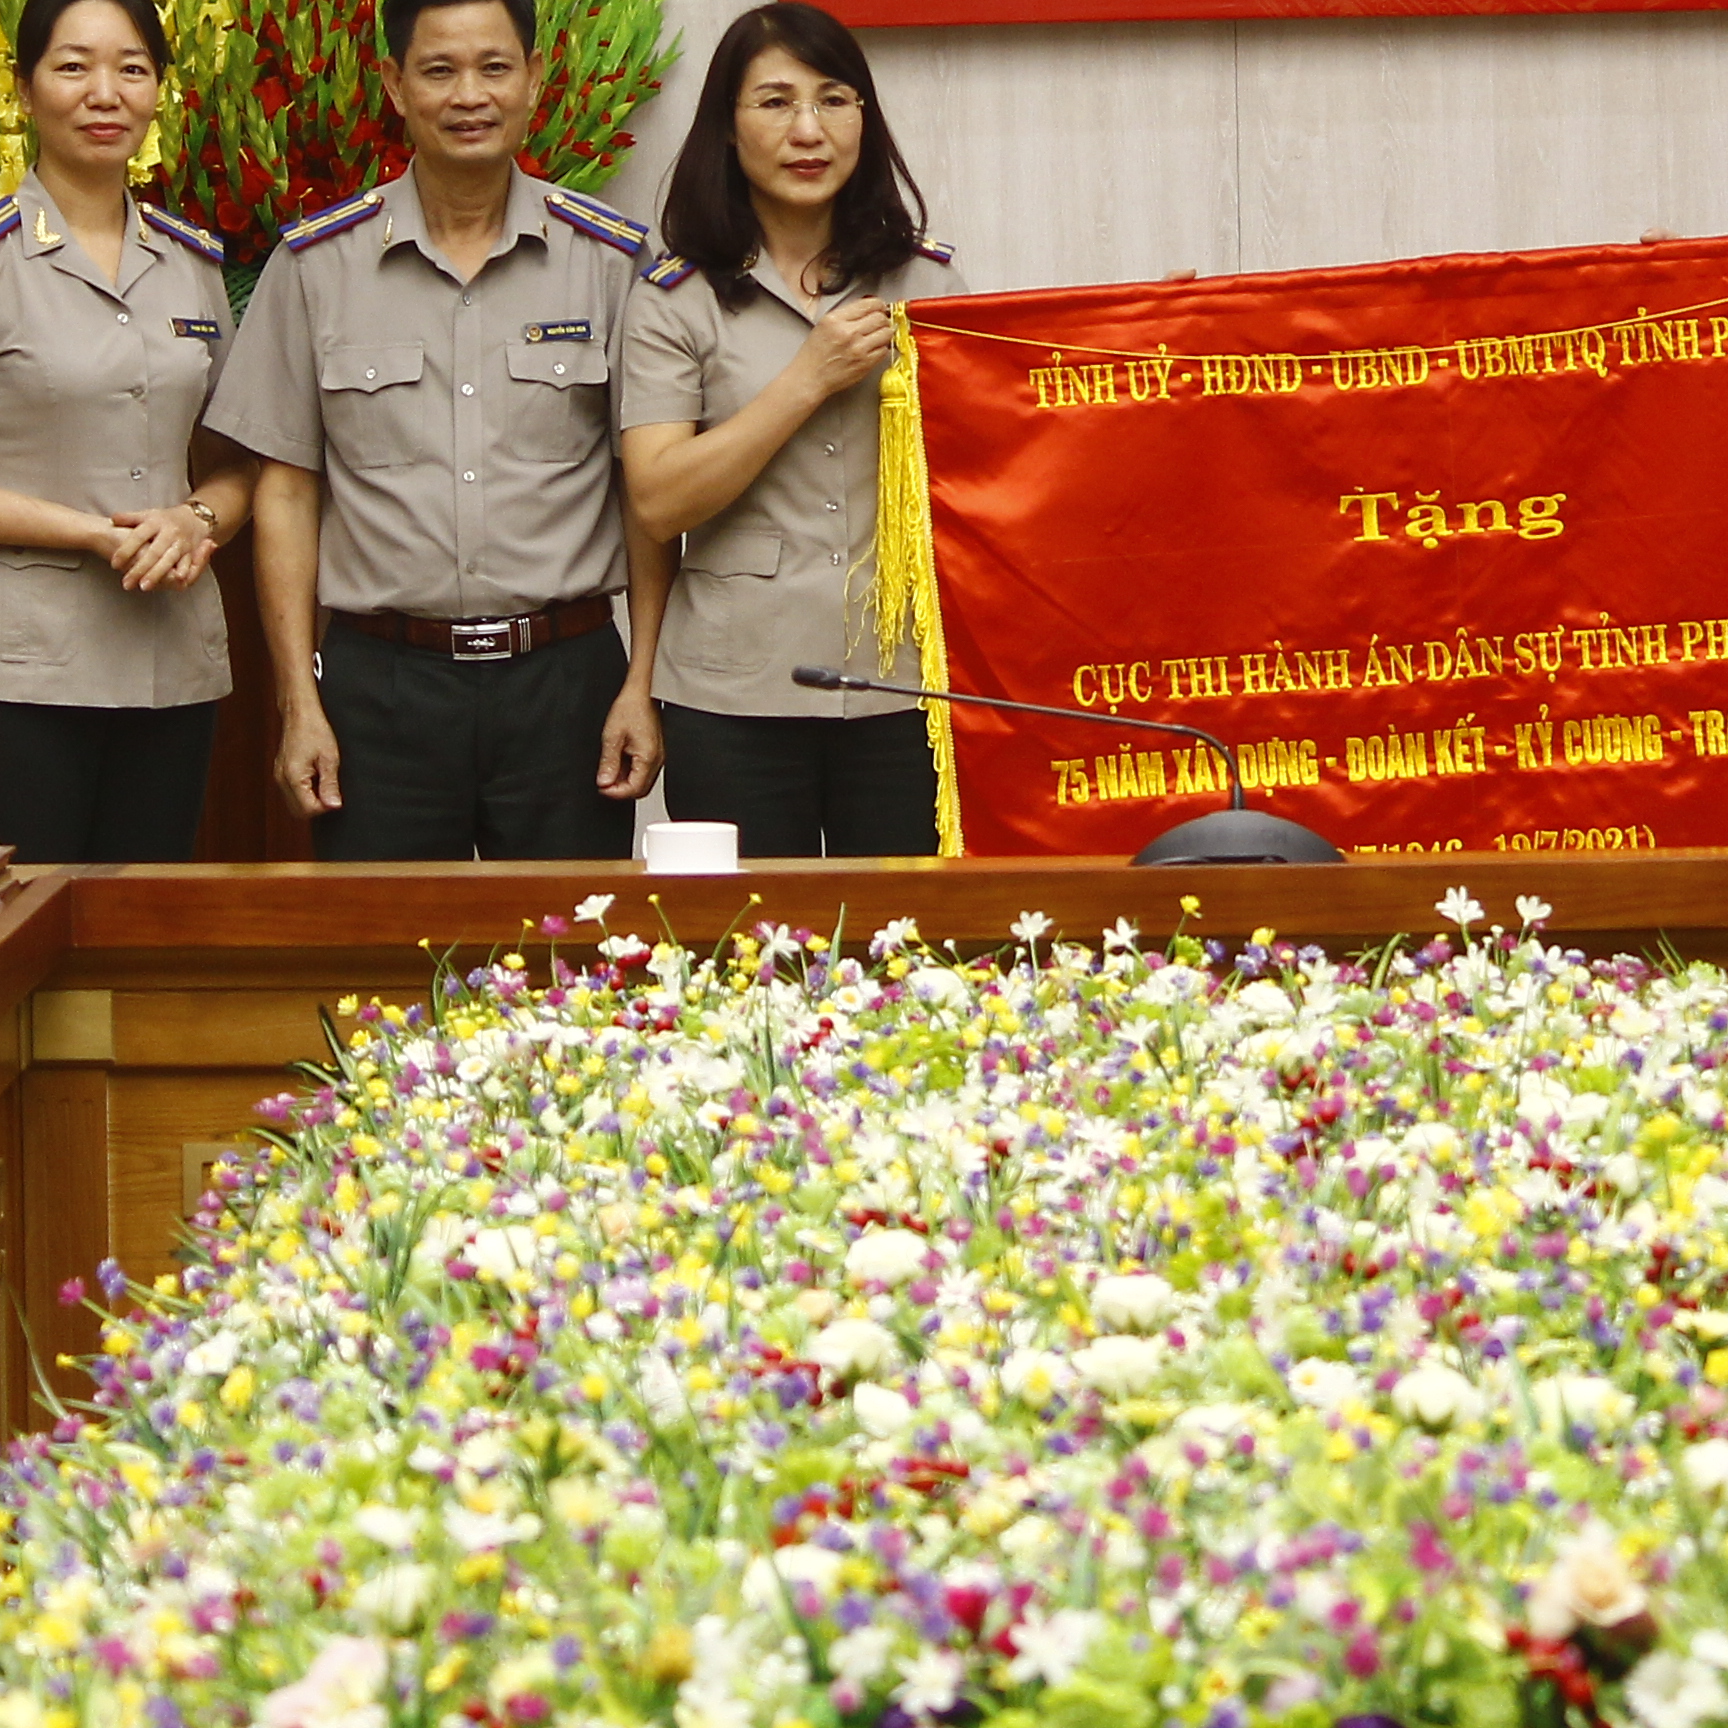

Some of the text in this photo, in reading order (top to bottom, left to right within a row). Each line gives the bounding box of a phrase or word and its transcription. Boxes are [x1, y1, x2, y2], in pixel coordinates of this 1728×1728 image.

[1029, 351, 1118, 408] TỈNH
[1124, 343, 1173, 401] UỶ
[1201, 353, 1304, 396] HĐND
[1329, 346, 1430, 391] UBND
[1455, 329, 1609, 380] UBMTTQ
[1613, 307, 1702, 366] TỈNH
[1339, 488, 1567, 550] Tặng
[1072, 660, 1152, 714] CỤC
[1161, 656, 1233, 700] THI
[1239, 640, 1353, 695] HÀNH
[1361, 633, 1415, 688] ÁN
[1423, 627, 1504, 682] DÂN
[1513, 624, 1565, 683] SỰ
[1572, 612, 1670, 670] TỈNH
[1052, 759, 1090, 806] 75
[1095, 743, 1167, 801] NĂM
[1171, 739, 1229, 795] XÂY
[1236, 736, 1320, 798] DỰNG
[1345, 724, 1428, 783] ĐOÀN
[1433, 712, 1487, 776] KẾT
[1514, 704, 1554, 770] KỶ
